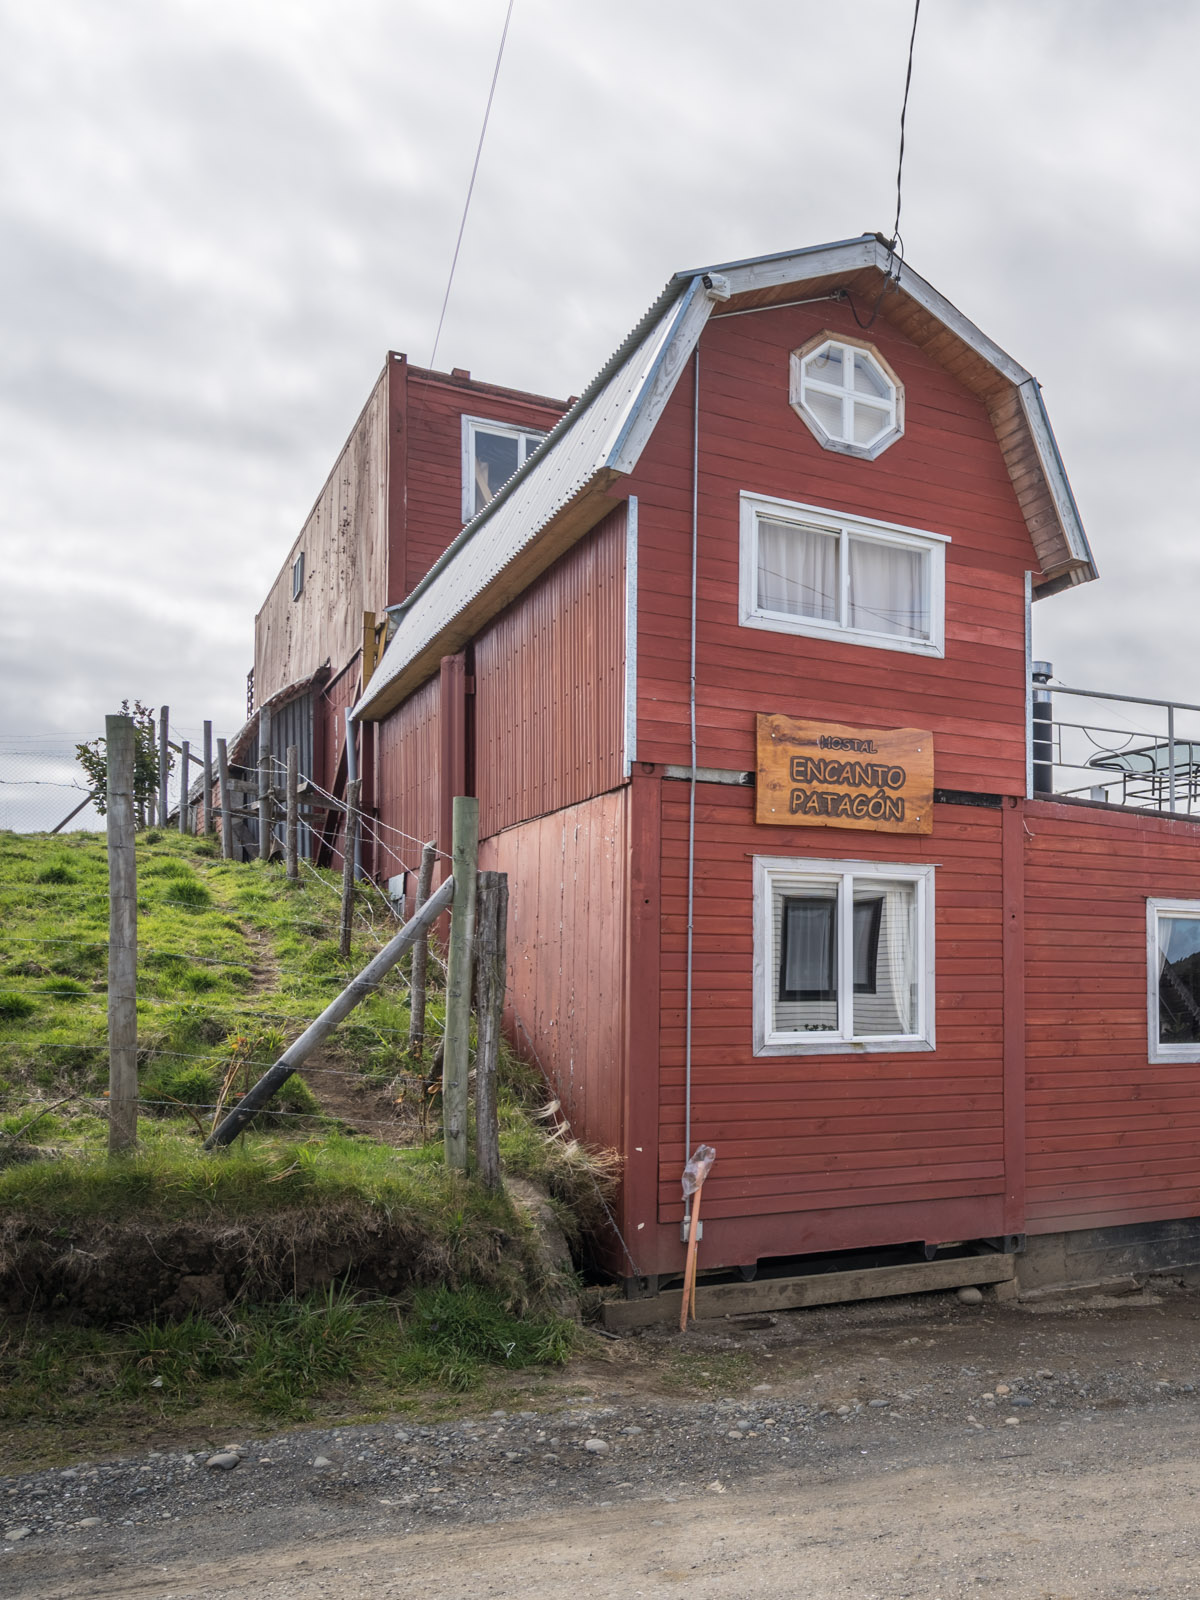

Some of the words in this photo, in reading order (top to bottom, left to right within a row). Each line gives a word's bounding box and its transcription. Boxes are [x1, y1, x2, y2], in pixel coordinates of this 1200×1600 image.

[819, 735, 877, 754] HOSTAL
[791, 757, 905, 789] ENCANTO
[791, 790, 904, 821] PATAGÓN
